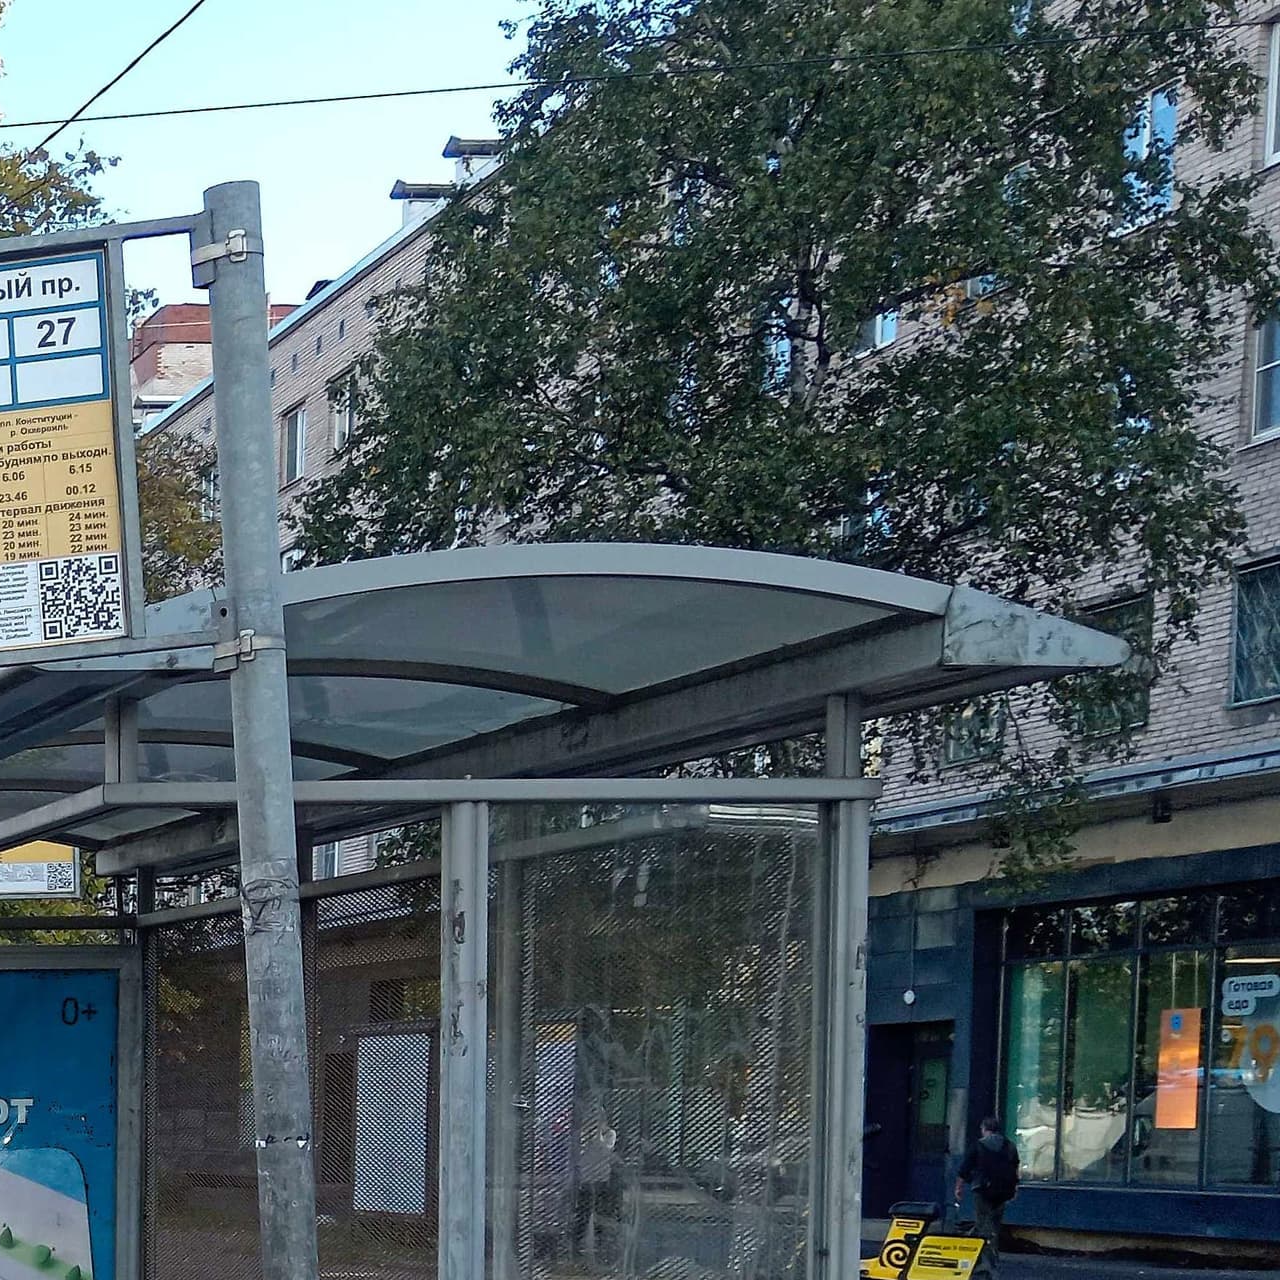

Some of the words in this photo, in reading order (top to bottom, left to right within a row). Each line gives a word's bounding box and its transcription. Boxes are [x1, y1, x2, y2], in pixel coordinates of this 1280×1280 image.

[41, 276, 81, 299] пр.
[36, 316, 77, 349] 27
[15, 412, 73, 426] Конституции
[7, 440, 52, 454] работы
[43, 453, 58, 463] по
[61, 447, 112, 461] выходн.
[69, 463, 92, 475] 6.15
[2, 471, 25, 482] 6.06
[65, 483, 96, 496] 00.12
[44, 498, 105, 514] движения
[68, 512, 81, 521] 24
[2, 520, 14, 529] 20
[69, 523, 82, 532] 23
[2, 531, 15, 540] 23
[69, 533, 82, 543] 22
[3, 541, 15, 551] 20
[70, 544, 83, 553] 22
[4, 552, 16, 561] 19
[61, 997, 97, 1025] 0+
